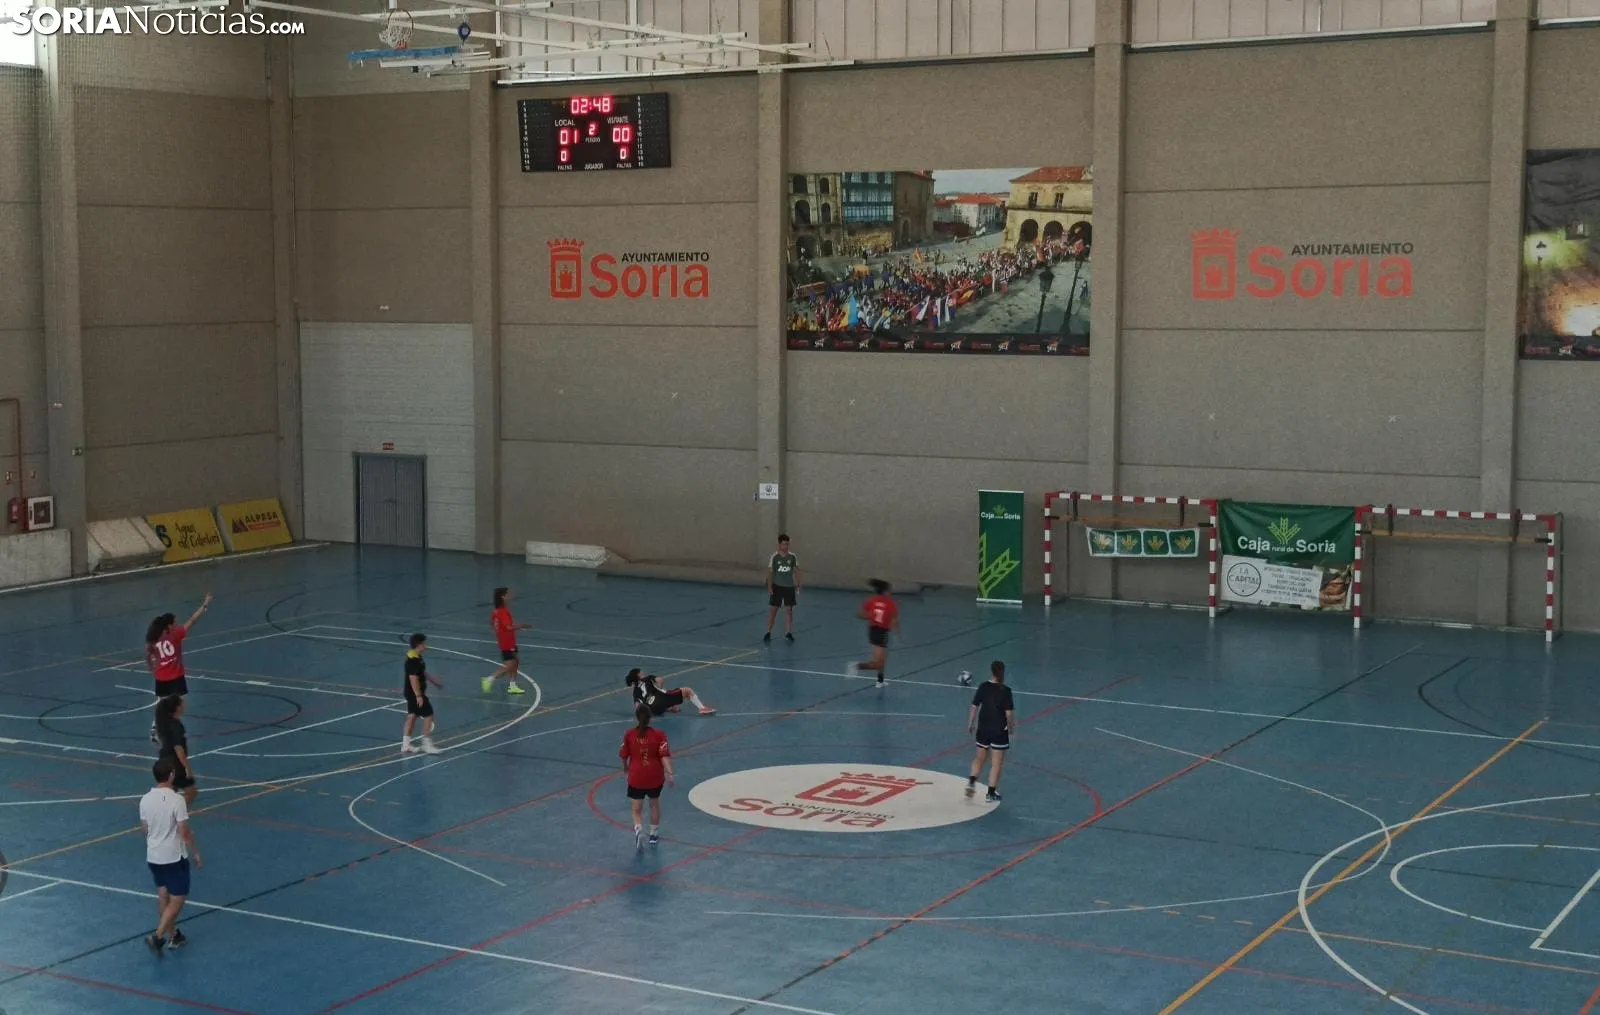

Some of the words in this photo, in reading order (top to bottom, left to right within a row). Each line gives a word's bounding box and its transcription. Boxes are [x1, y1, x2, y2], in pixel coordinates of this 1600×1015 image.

[570, 97, 611, 114] 02:48
[554, 119, 576, 127] LOCAL
[588, 123, 596, 136] 2
[560, 129, 578, 145] 01
[612, 127, 630, 143] 00
[560, 150, 568, 162] 0
[620, 148, 627, 160] 0
[621, 251, 710, 263] AYUNTAMIENTO
[1291, 242, 1414, 256] AYUNTAMIENTO
[588, 253, 709, 299] Soria
[1245, 246, 1414, 299] Soria
[1237, 536, 1271, 553] Caja
[1296, 539, 1336, 553] Soria
[155, 640, 175, 659] 10
[719, 797, 887, 828] Soria
[781, 801, 895, 819] AYUNTAMIENTO
